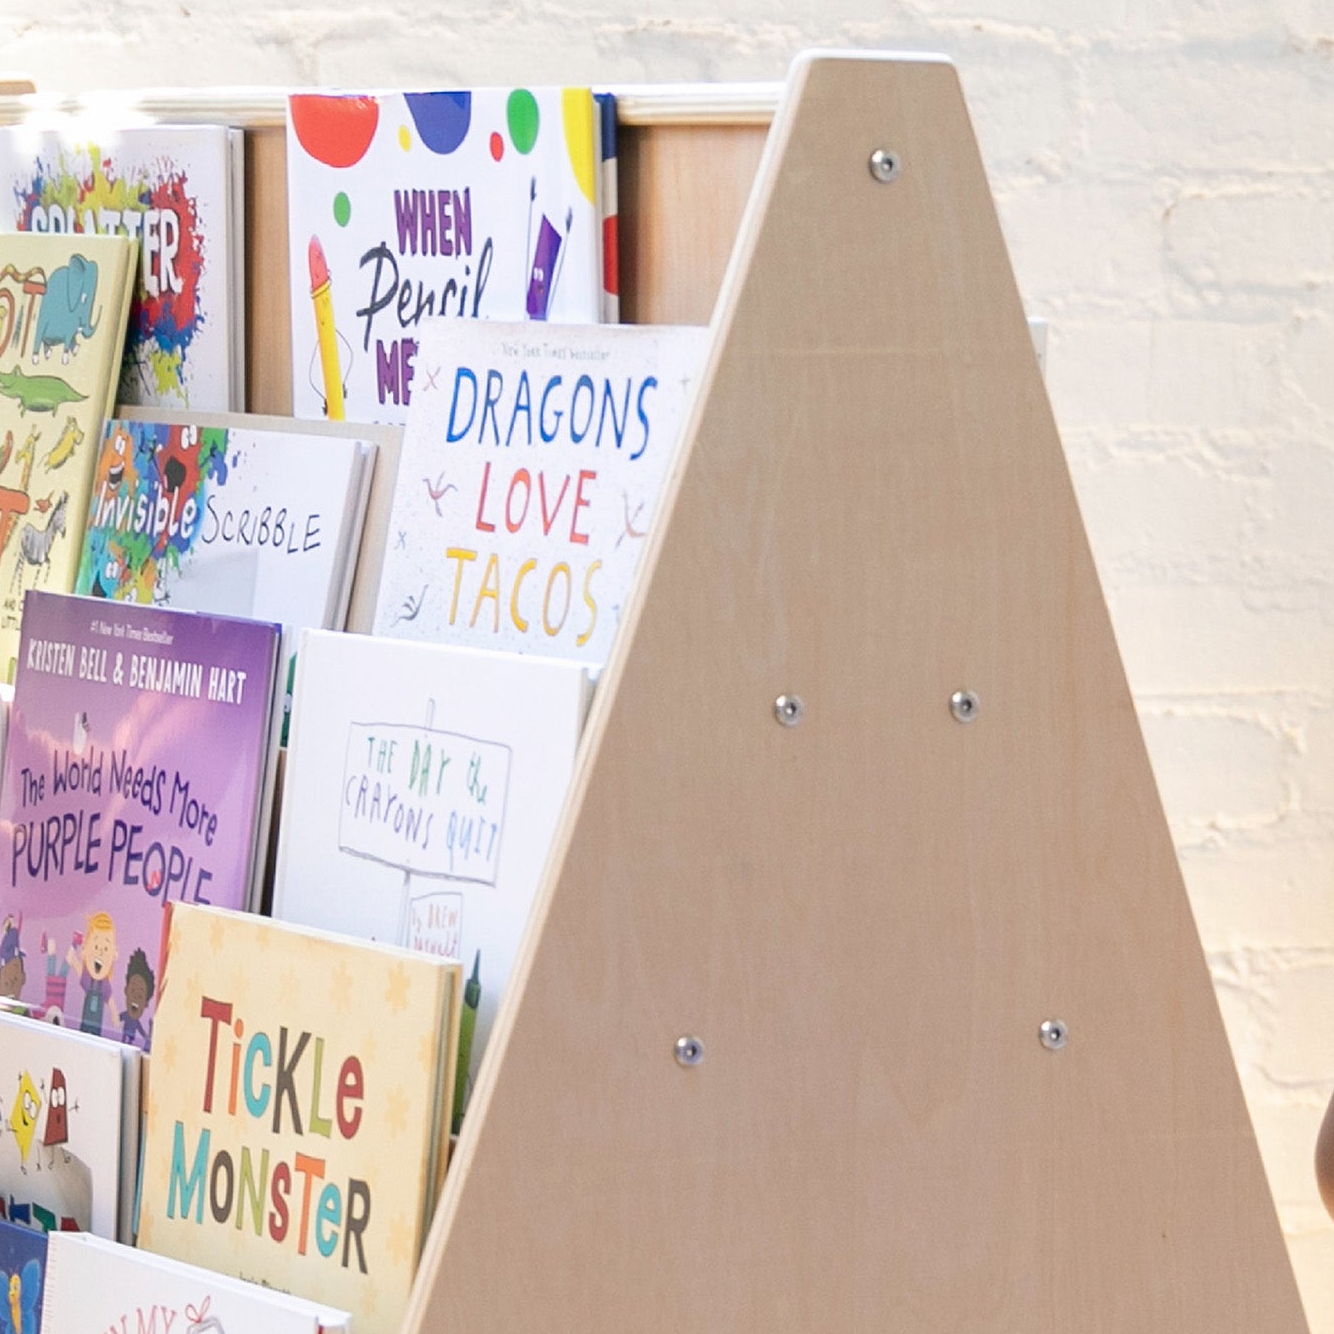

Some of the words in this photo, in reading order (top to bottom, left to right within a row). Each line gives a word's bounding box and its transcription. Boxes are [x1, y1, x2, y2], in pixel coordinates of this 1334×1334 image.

[394, 187, 472, 259] WHEN
[356, 236, 493, 353] Pencil
[375, 336, 419, 407] ME
[445, 366, 658, 461] DRAGONS
[475, 461, 598, 546] LOVE
[445, 547, 602, 648] TACOS
[27, 638, 77, 678] KRISTEN
[79, 646, 108, 683] BELL
[112, 652, 124, 686] &
[129, 654, 204, 699] BENJAMIN
[207, 667, 247, 705] HART
[20, 767, 46, 808] The
[53, 745, 104, 797] World
[169, 771, 218, 847] More
[367, 736, 398, 775] THE
[408, 739, 452, 798] DAY
[345, 773, 434, 850] CRAYONS
[11, 809, 101, 887] PURPLE
[107, 818, 213, 906] PEOPLE
